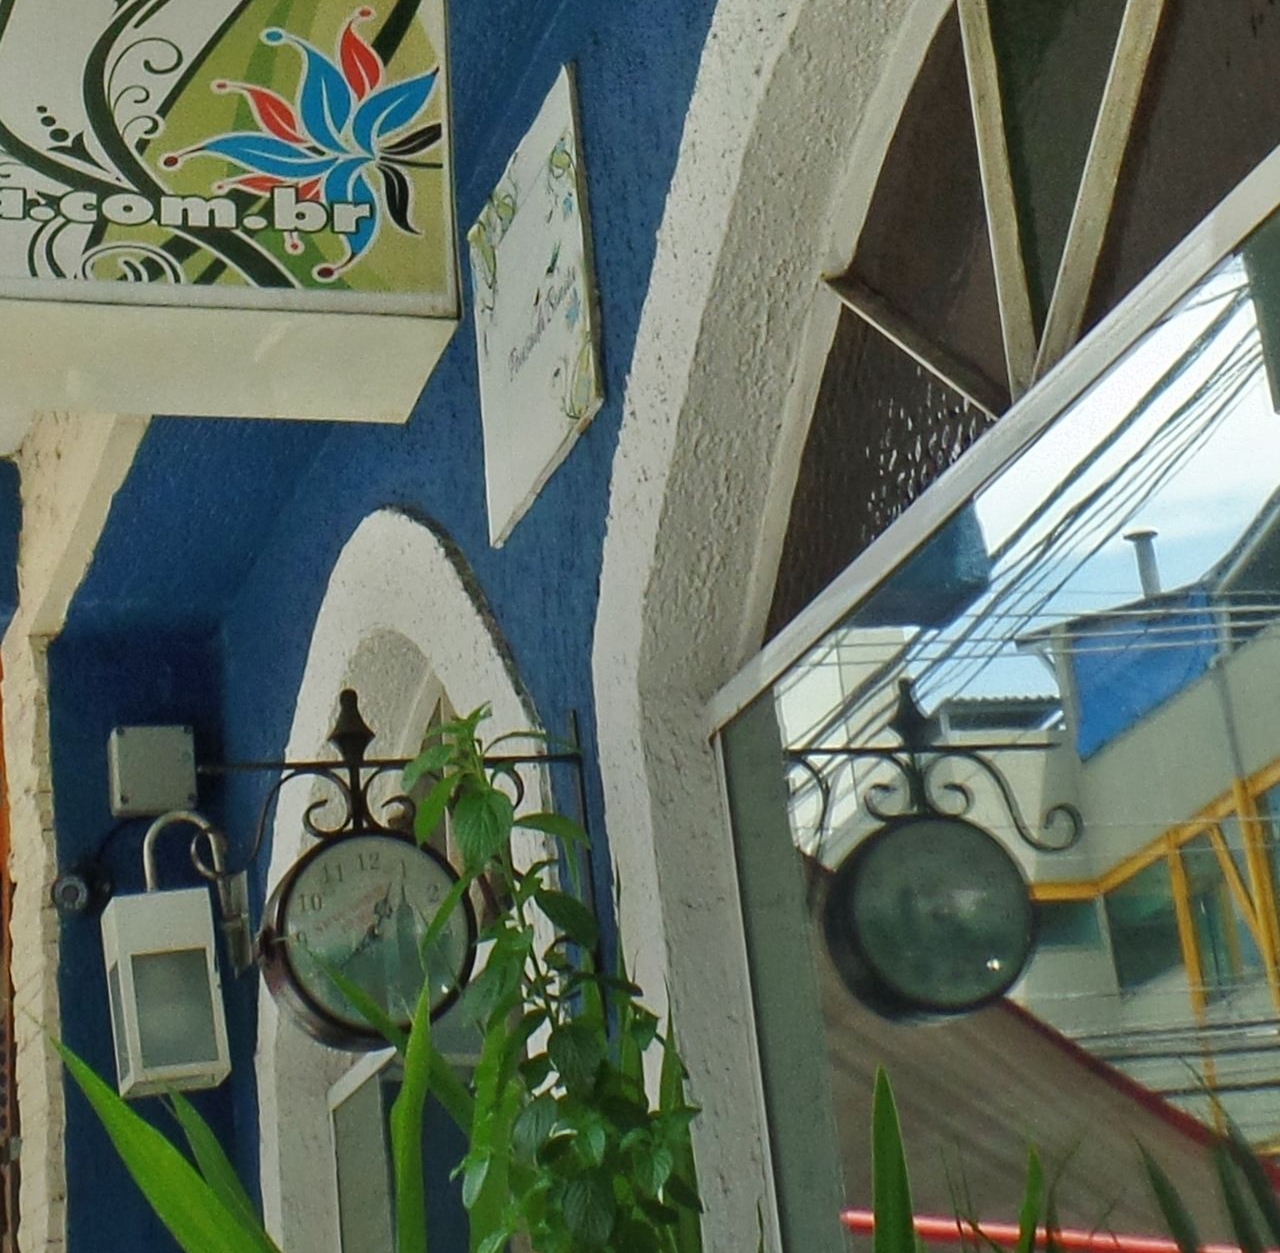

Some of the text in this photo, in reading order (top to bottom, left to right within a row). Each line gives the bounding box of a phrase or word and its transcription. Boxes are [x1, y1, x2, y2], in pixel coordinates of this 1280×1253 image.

[357, 852, 380, 871] 12
[321, 862, 343, 884] 11
[299, 893, 322, 913] 10
